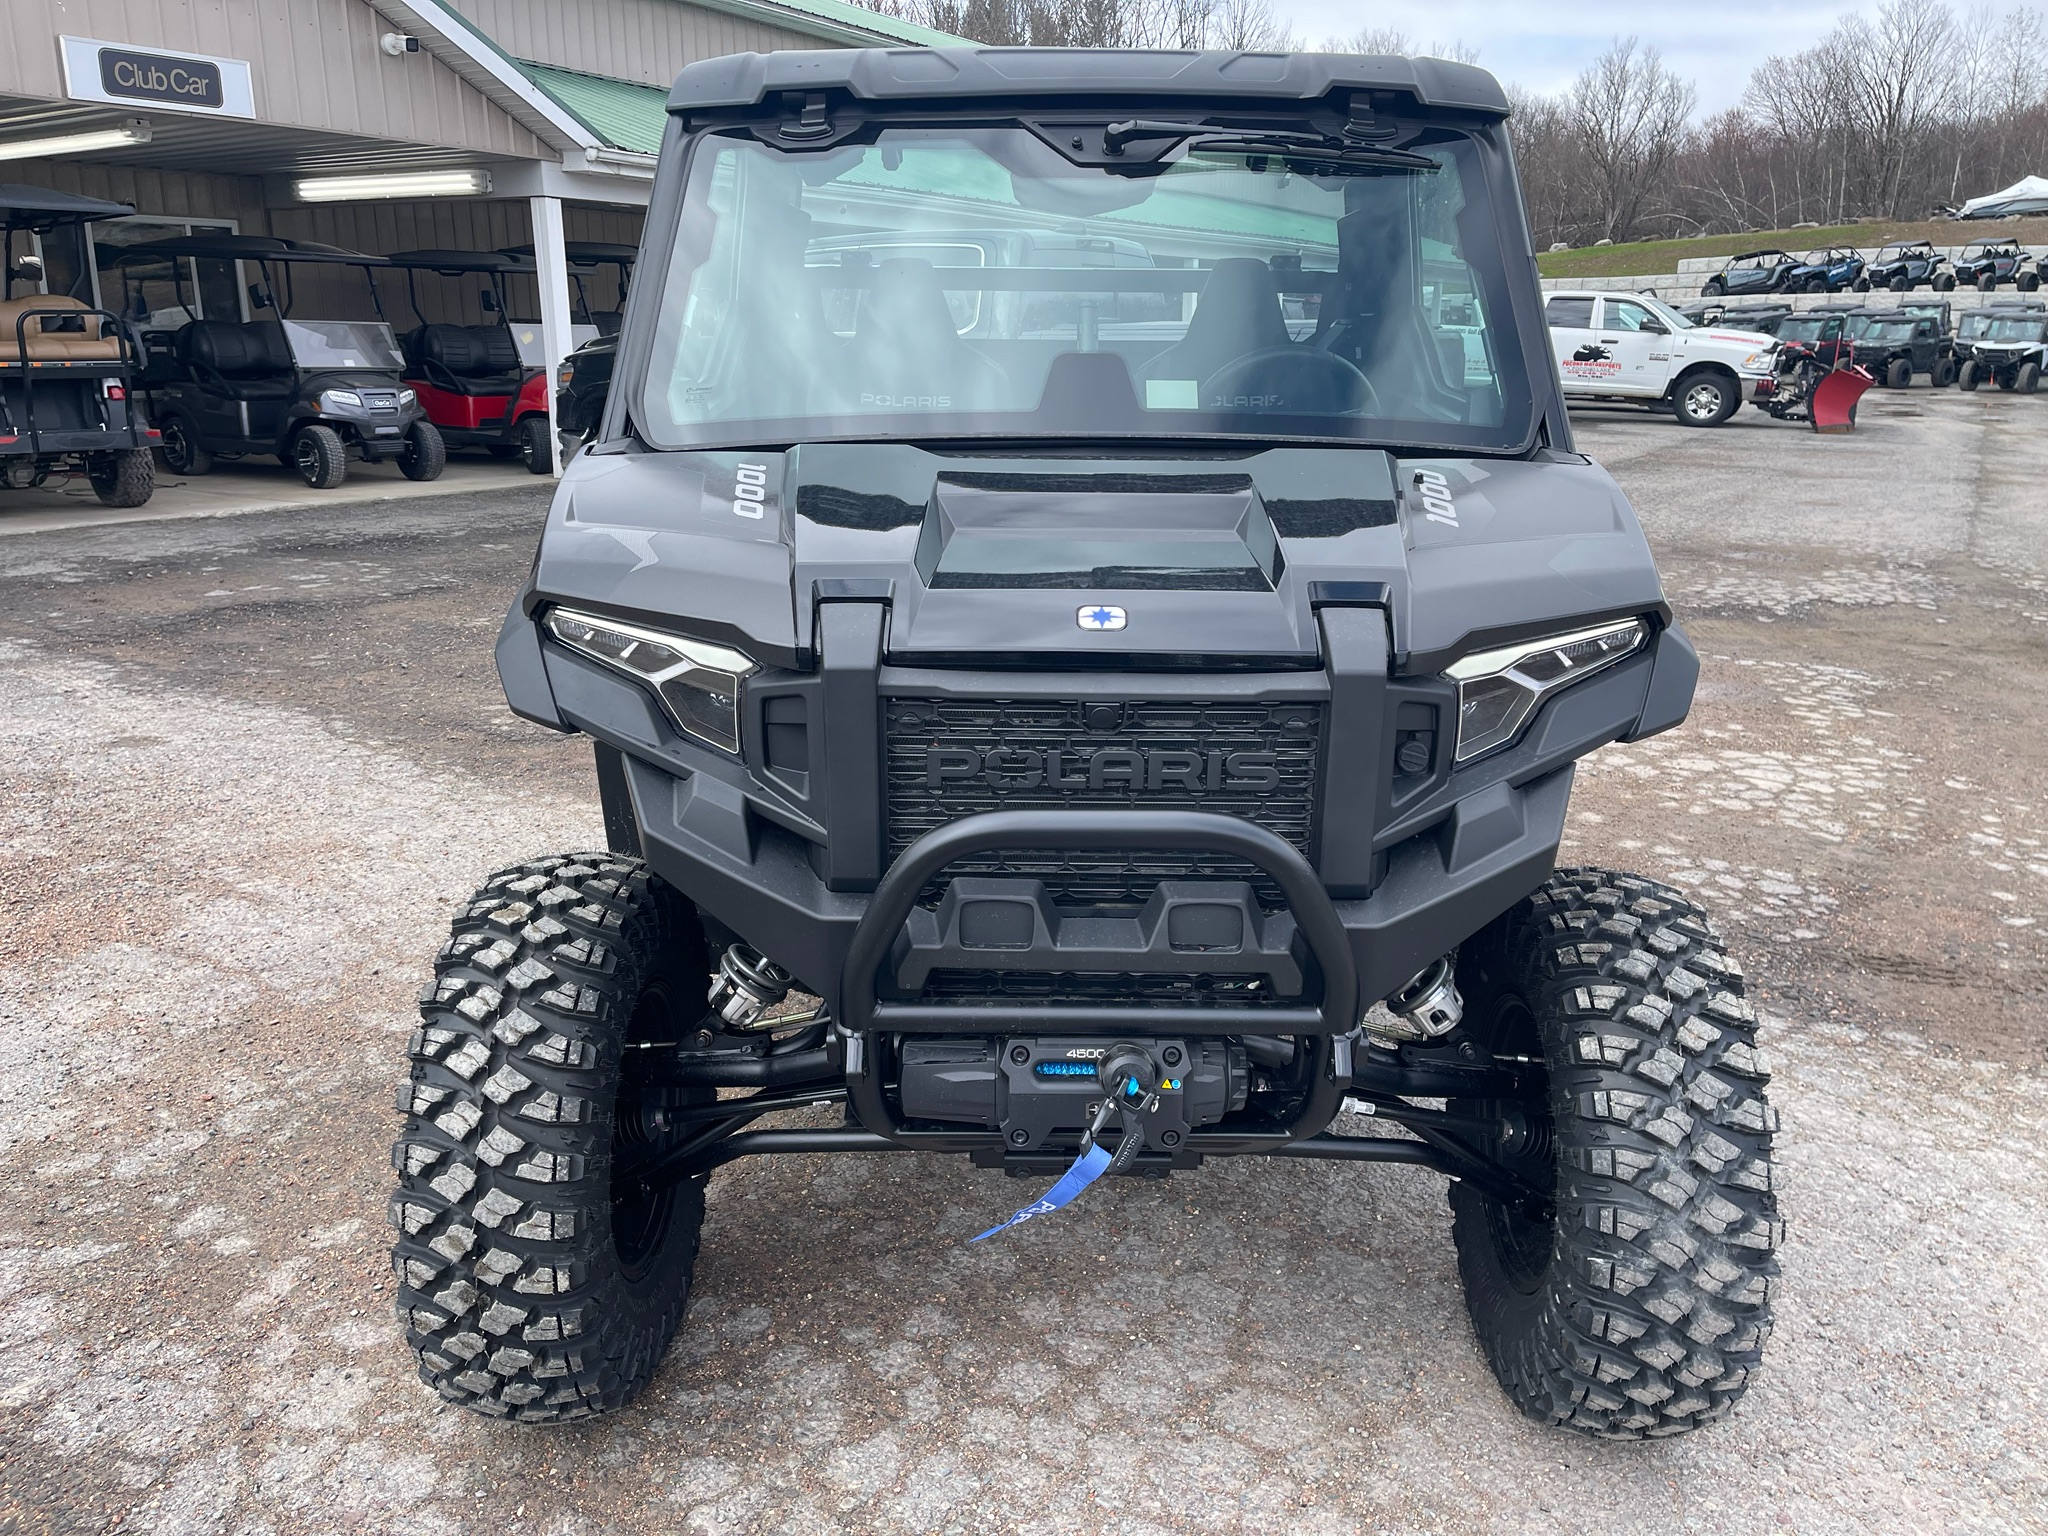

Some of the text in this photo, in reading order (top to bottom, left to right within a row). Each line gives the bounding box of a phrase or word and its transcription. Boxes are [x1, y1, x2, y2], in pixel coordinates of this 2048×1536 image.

[113, 61, 209, 96] Club Car
[1584, 361, 1622, 370] MOTORSPORTS
[860, 392, 952, 408] POLARIS
[733, 463, 767, 520] 1000
[1414, 468, 1459, 528] 1000
[926, 748, 1280, 792] POLARIS
